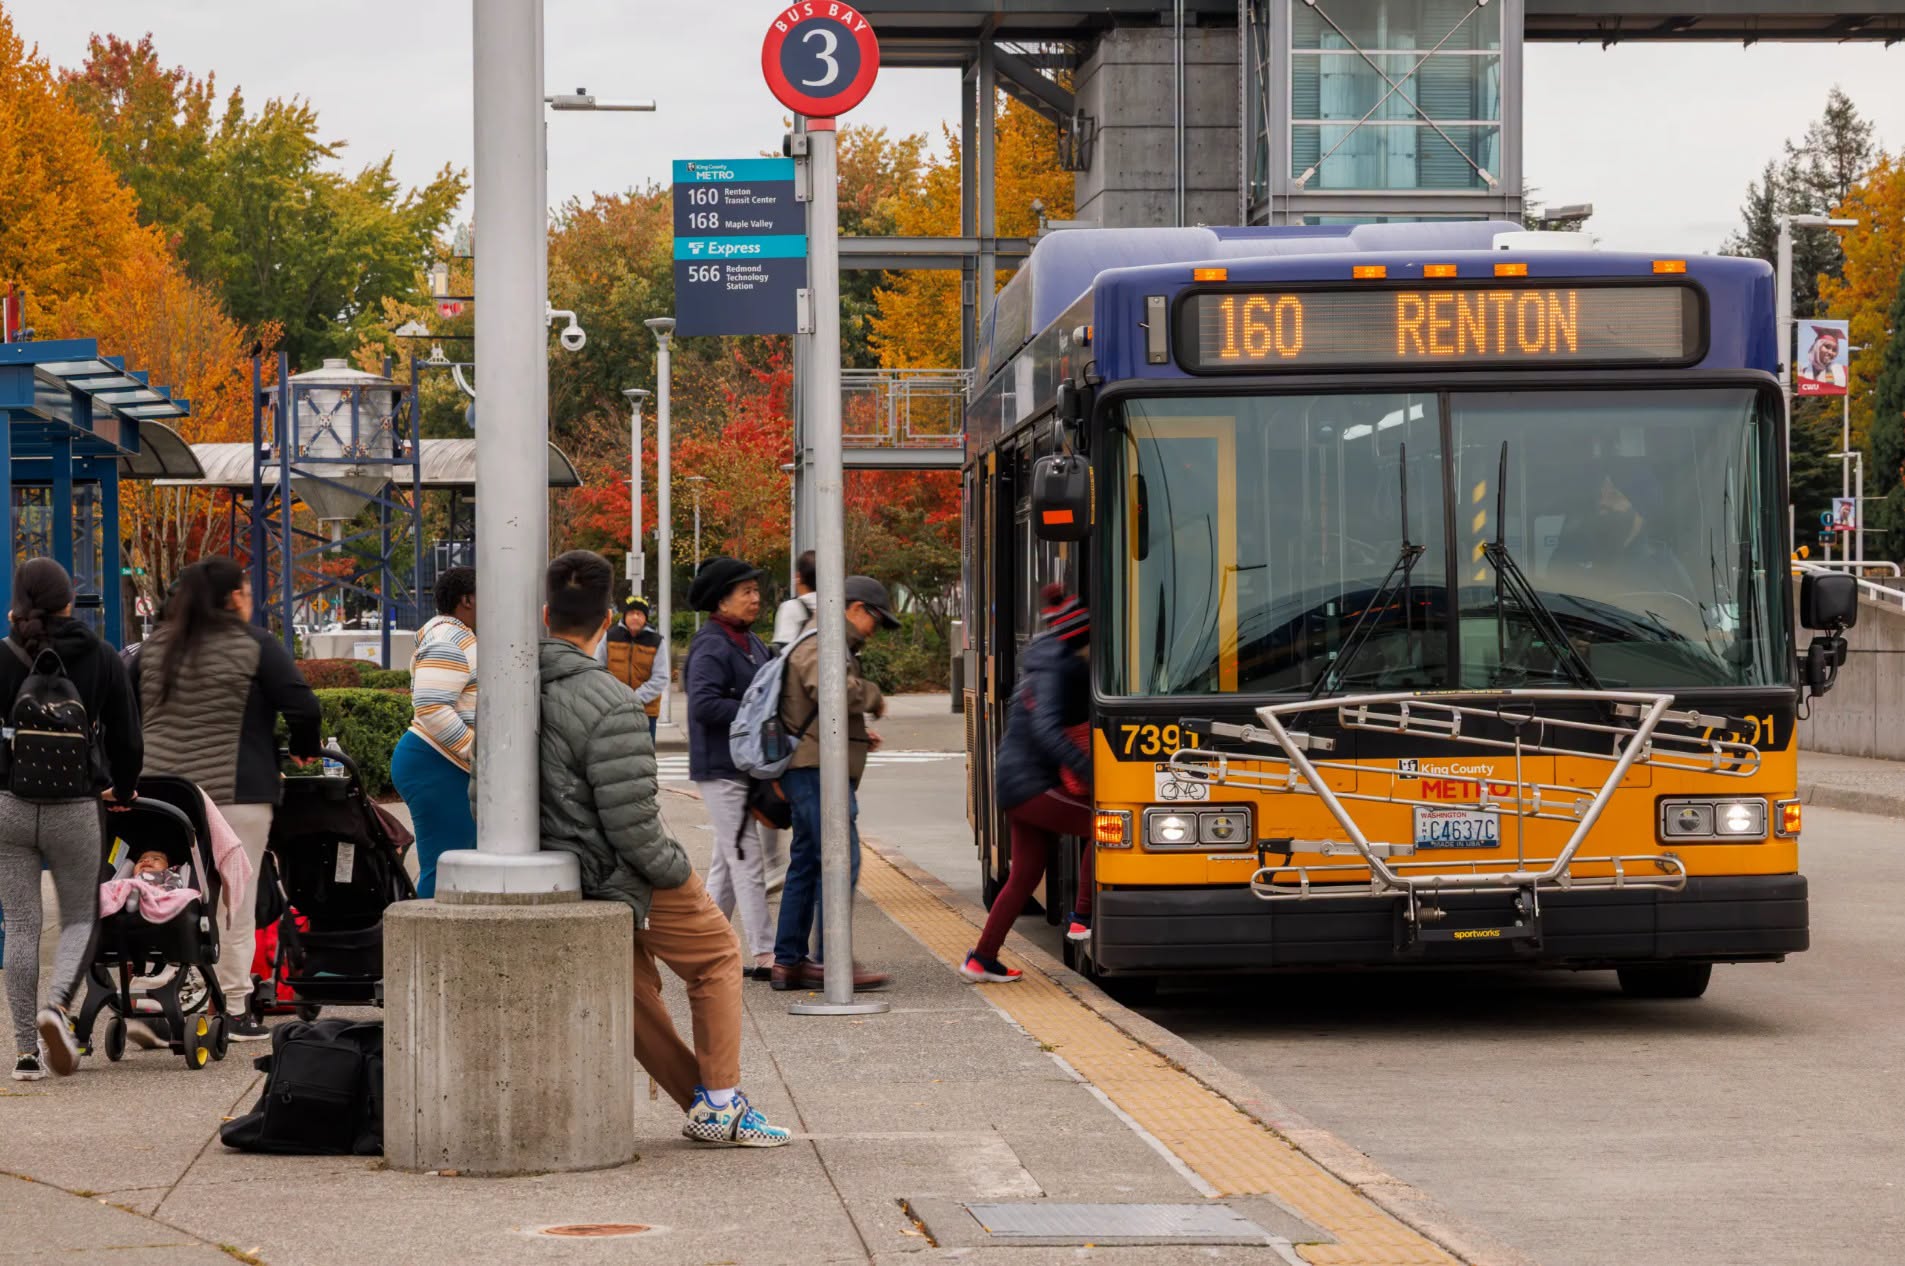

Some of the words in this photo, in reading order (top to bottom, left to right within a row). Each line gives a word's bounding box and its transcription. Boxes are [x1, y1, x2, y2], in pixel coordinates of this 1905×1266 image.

[775, 3, 814, 32] BUS
[828, 3, 867, 32] BAY
[801, 28, 839, 87] 3
[696, 170, 735, 180] METRO
[688, 188, 719, 205] 160
[724, 188, 751, 196] Renton
[724, 196, 750, 204] Transit
[751, 196, 776, 204] Center
[688, 212, 719, 229] 168
[725, 220, 748, 230] Maple
[750, 219, 773, 229] Valley
[708, 241, 761, 257] Express
[688, 265, 720, 283] 566
[726, 264, 762, 273] Redmond
[726, 273, 769, 283] Technology
[726, 282, 754, 291] Station
[1220, 296, 1304, 359] 160
[1396, 290, 1578, 357] RENTON
[1421, 764, 1449, 774] King
[1451, 763, 1494, 776] County
[1422, 779, 1512, 799] METO
[1430, 819, 1495, 841] C4637C
[1454, 930, 1500, 940] sportworks
